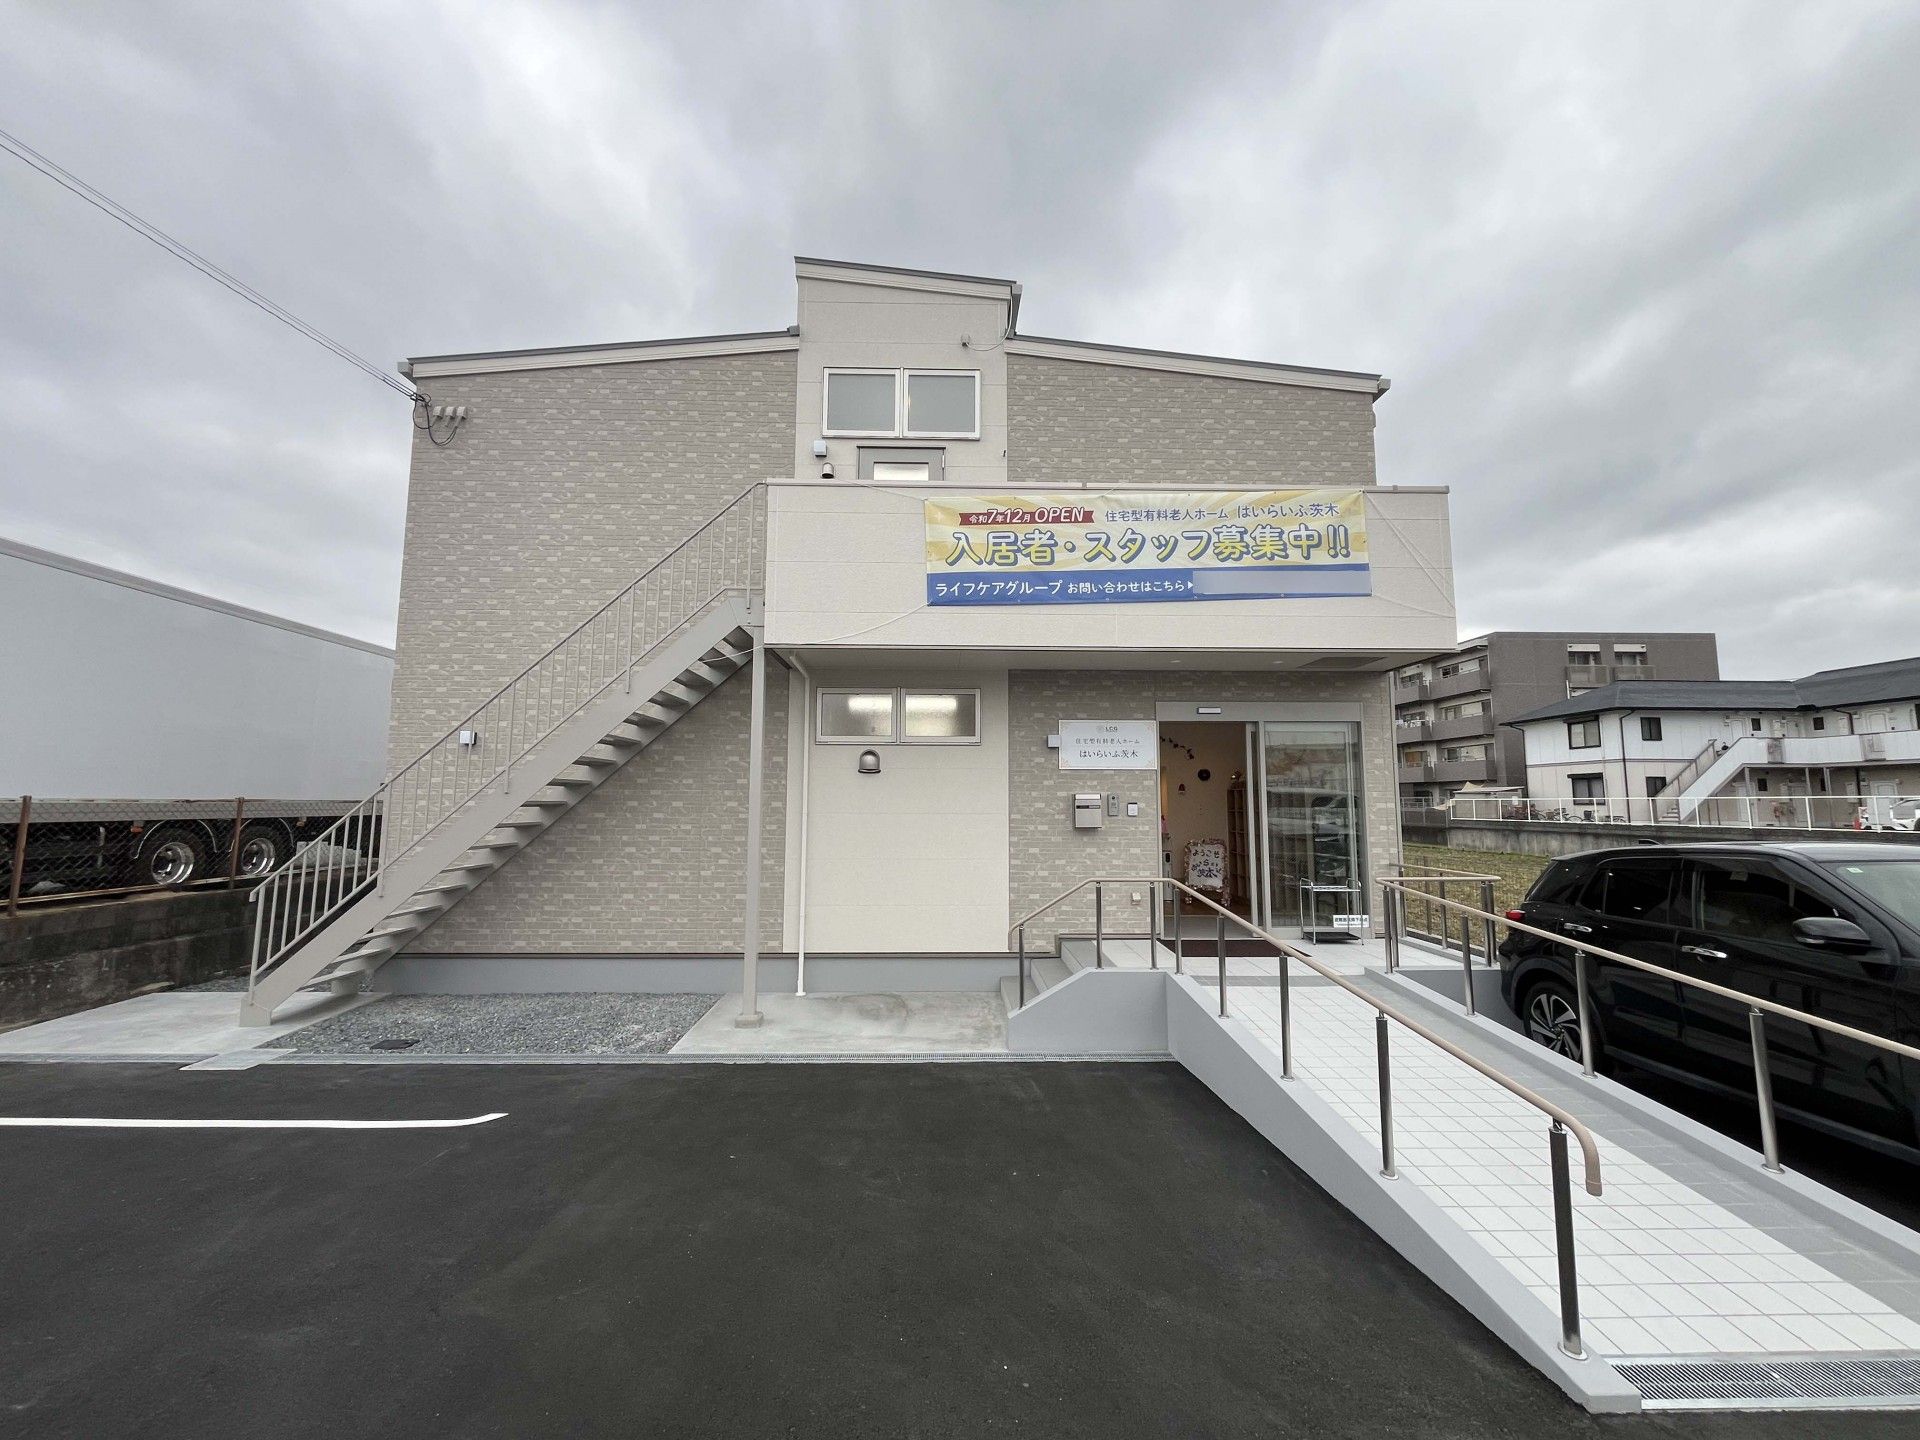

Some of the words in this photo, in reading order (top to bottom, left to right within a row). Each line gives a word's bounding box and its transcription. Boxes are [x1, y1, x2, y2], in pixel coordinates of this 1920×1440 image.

[969, 509, 1031, 524] 令和7年12月
[1035, 507, 1085, 523] OPEN
[1105, 508, 1229, 522] 住宅型有料老人ホーム
[1237, 503, 1340, 518] はいらいふ茨木
[935, 580, 1063, 597] ライフケアグループ
[1067, 580, 1185, 595] お問い合わせはこちら
[1080, 749, 1139, 758] はいらいふ茨木
